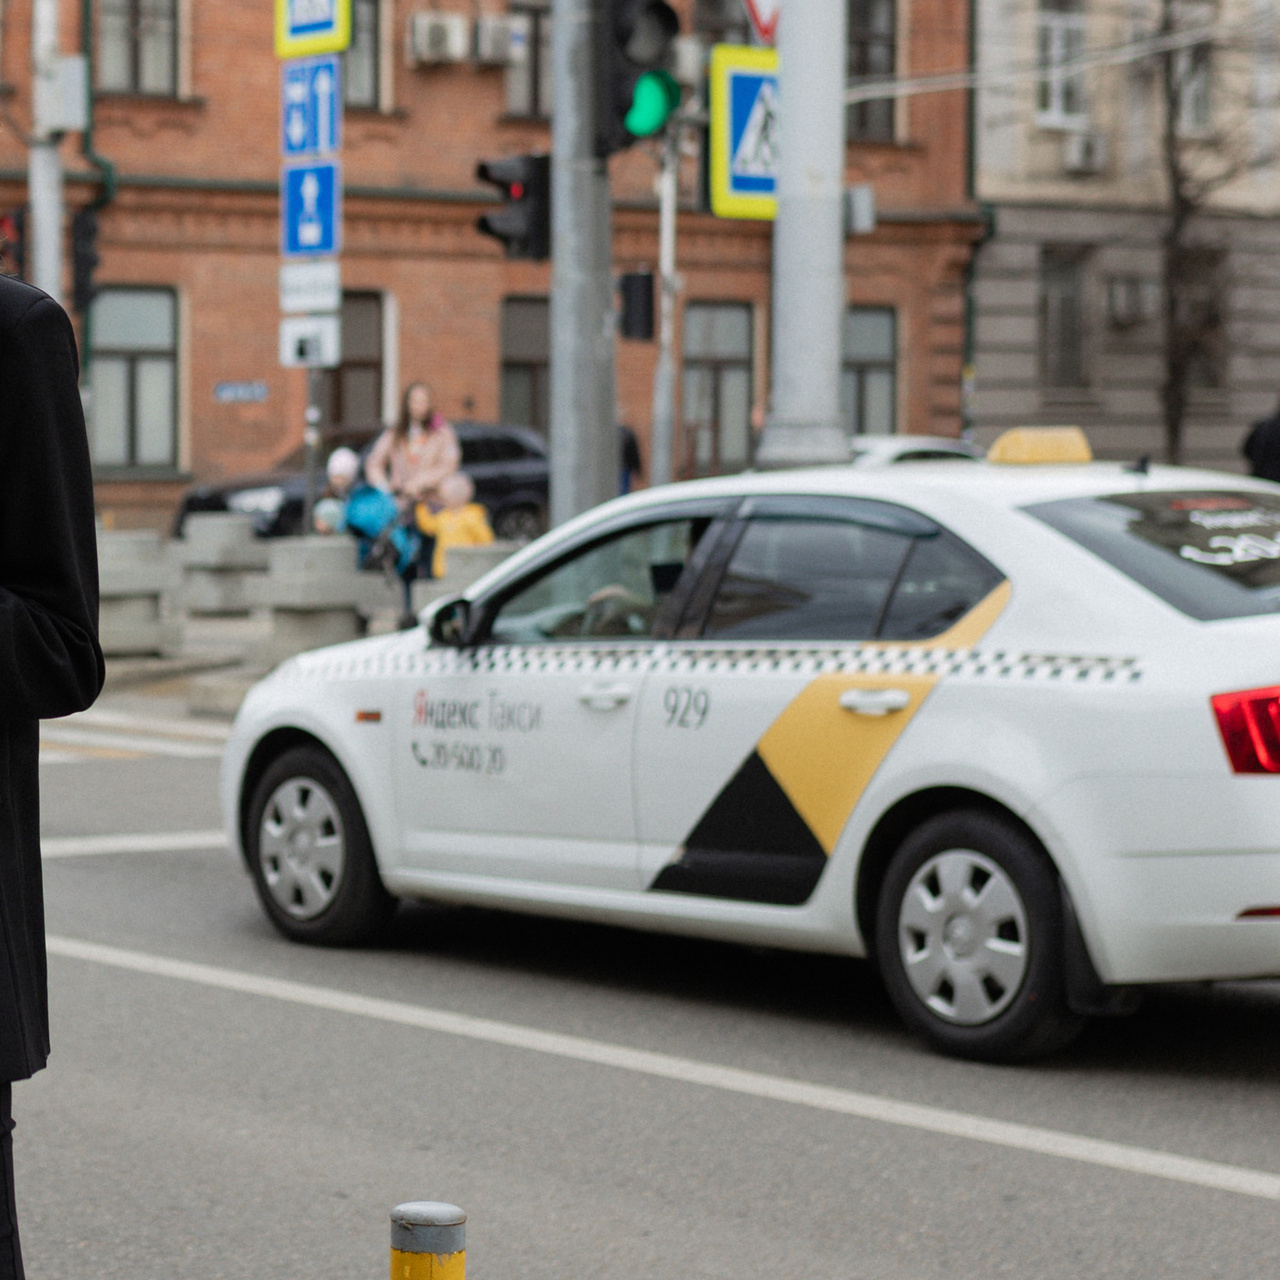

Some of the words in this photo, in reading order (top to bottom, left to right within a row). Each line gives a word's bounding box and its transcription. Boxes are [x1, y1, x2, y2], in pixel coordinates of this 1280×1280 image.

[412, 689, 480, 731] Яндекс
[486, 690, 542, 733] Такси
[665, 687, 709, 729] 929
